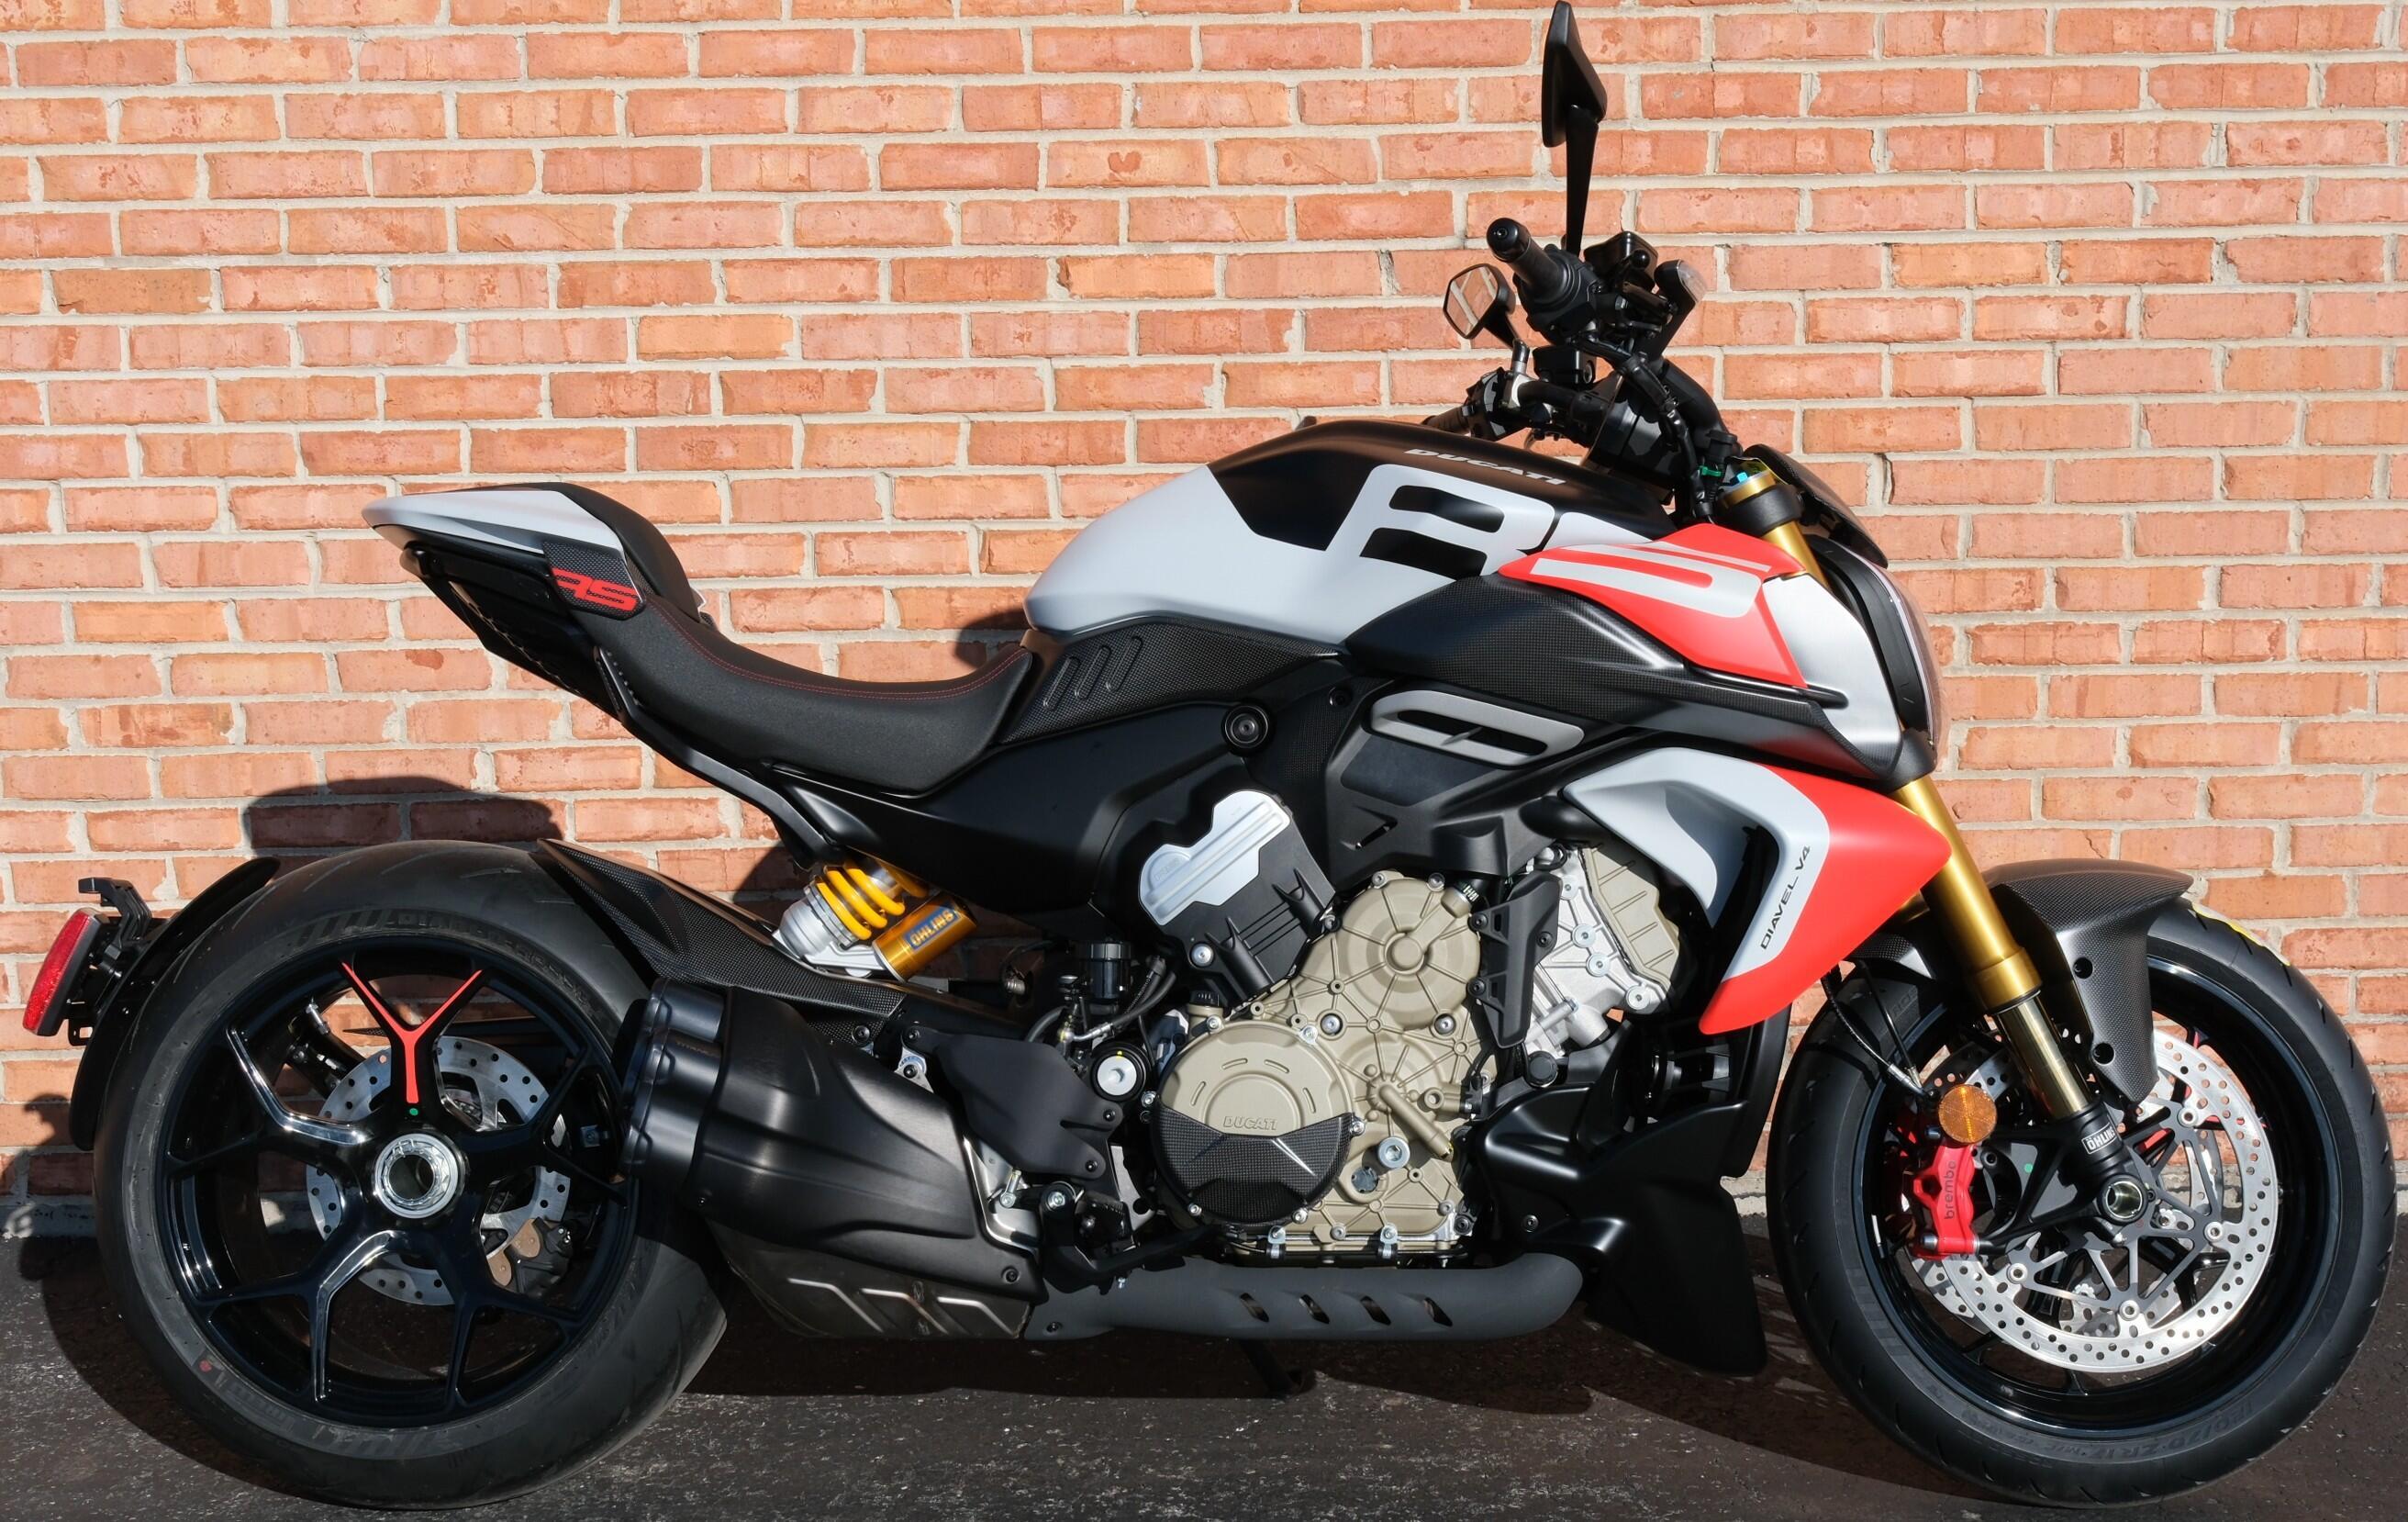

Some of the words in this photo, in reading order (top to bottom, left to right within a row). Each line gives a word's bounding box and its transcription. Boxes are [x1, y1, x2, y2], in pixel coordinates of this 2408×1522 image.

[1404, 448, 1566, 486] DUCATI
[1760, 876, 1799, 950] DIAVEL
[1795, 845, 1811, 870] V4
[1223, 1115, 1276, 1131] DUCATI
[1945, 1160, 1956, 1220] brembo
